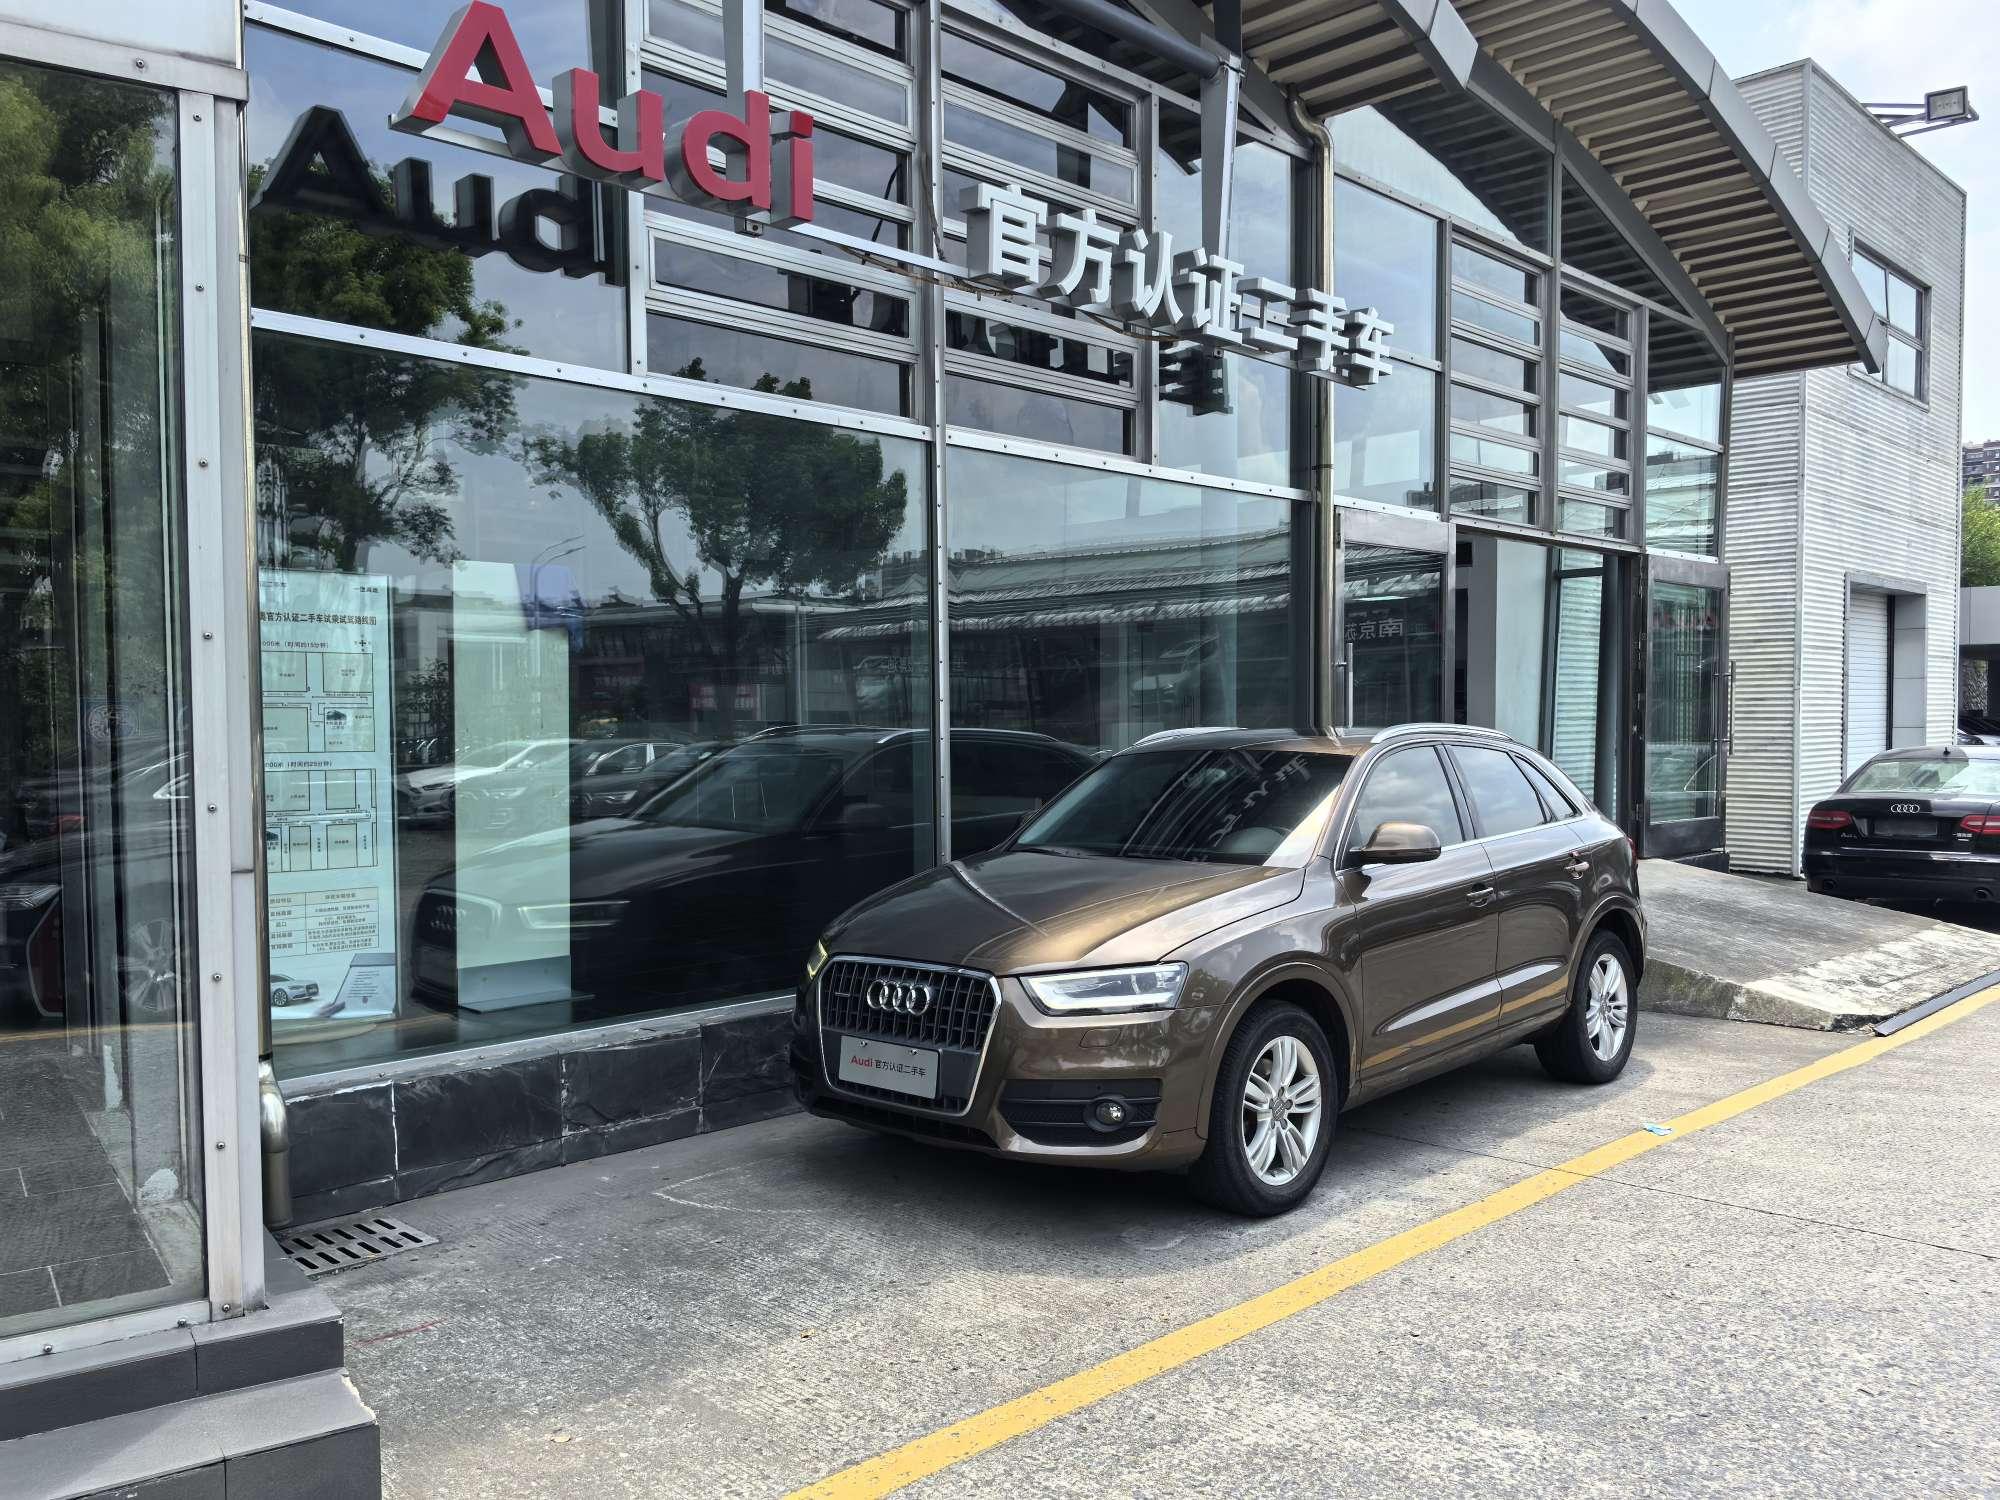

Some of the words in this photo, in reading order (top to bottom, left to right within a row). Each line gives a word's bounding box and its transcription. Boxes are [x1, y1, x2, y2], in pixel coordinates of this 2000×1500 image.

[398, 0, 814, 224] Audi
[960, 182, 1395, 385] 官方认证二手车
[850, 1055, 874, 1068] Audi
[875, 1059, 926, 1078] 官方认证二手车
